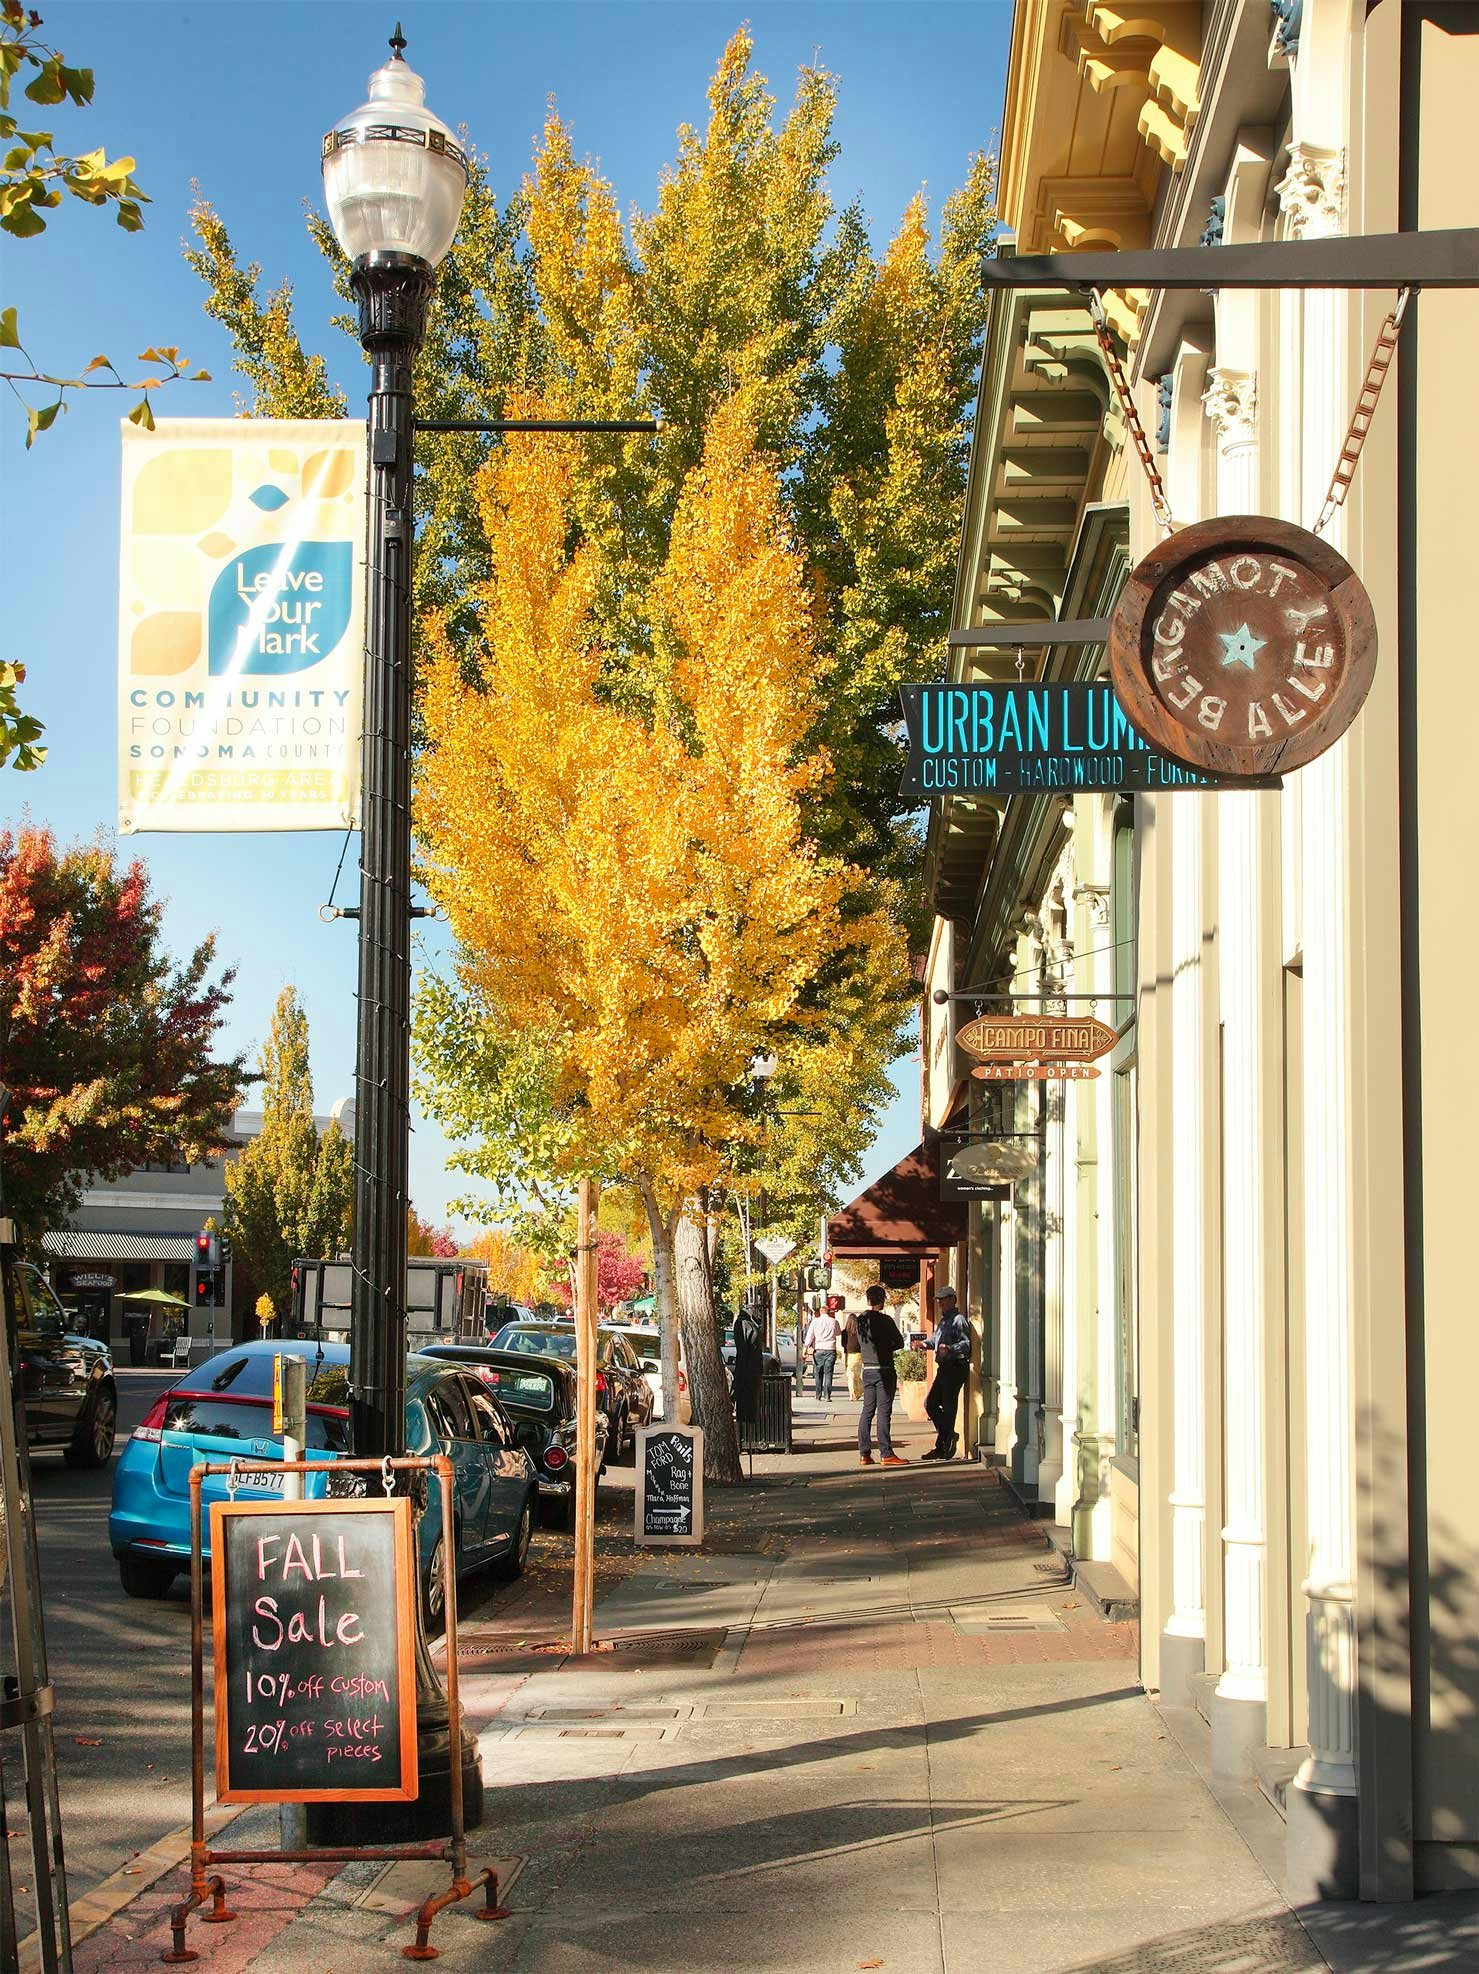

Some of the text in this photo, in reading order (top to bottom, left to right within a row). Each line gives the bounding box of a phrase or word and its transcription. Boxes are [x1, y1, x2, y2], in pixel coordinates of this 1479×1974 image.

[922, 689, 1049, 753] URBAN
[266, 743, 343, 759] COUNT
[135, 772, 275, 787] HELDSBURG
[923, 757, 996, 788] CUSTOM
[1019, 756, 1123, 787] HARDWOOD
[983, 1028, 1090, 1049] CAMPO FINA
[984, 1067, 1090, 1078] PATIO OPEN
[646, 1440, 671, 1459] TOM
[670, 1434, 693, 1464] Rails
[650, 1452, 674, 1470] FORD
[670, 1465, 687, 1482] Rag
[670, 1479, 689, 1491] Bone
[646, 1513, 687, 1526] Champagne
[673, 1523, 688, 1533] $20
[257, 1532, 366, 1581] FALL
[252, 1594, 365, 1651] Sale
[246, 1671, 296, 1707] 10%
[297, 1674, 324, 1698] off
[243, 1719, 289, 1755] 20%
[290, 1720, 315, 1737] off
[327, 1743, 383, 1763] pieces
